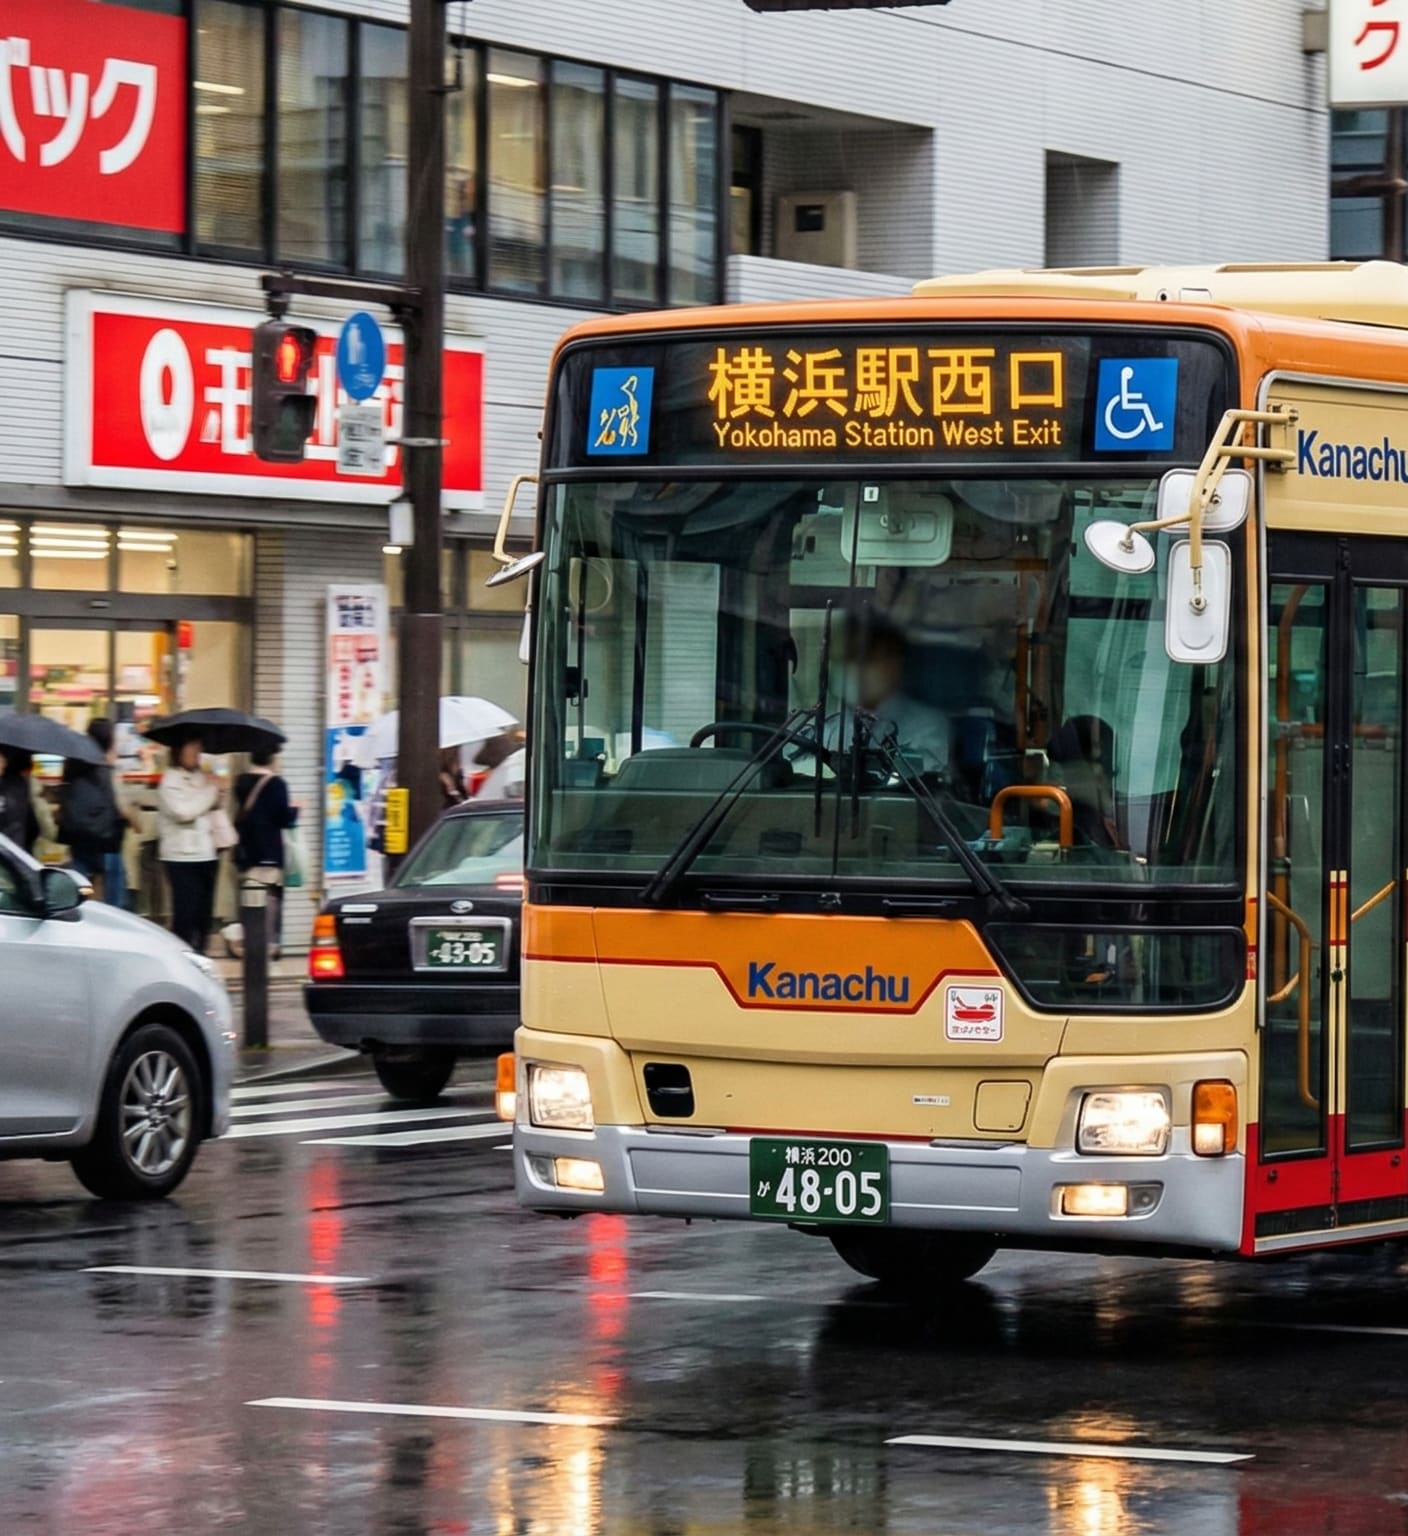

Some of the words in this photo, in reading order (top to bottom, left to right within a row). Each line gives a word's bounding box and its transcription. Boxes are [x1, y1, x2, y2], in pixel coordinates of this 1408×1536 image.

[1354, 0, 1399, 70] ク
[708, 347, 1062, 418] 横浜駅西口
[713, 422, 835, 447] Yokohama
[846, 422, 933, 446] Station
[943, 422, 1004, 445] West
[1012, 420, 1061, 446] Exit
[748, 962, 909, 1002] Kanachu
[776, 1168, 881, 1216] 48-05
